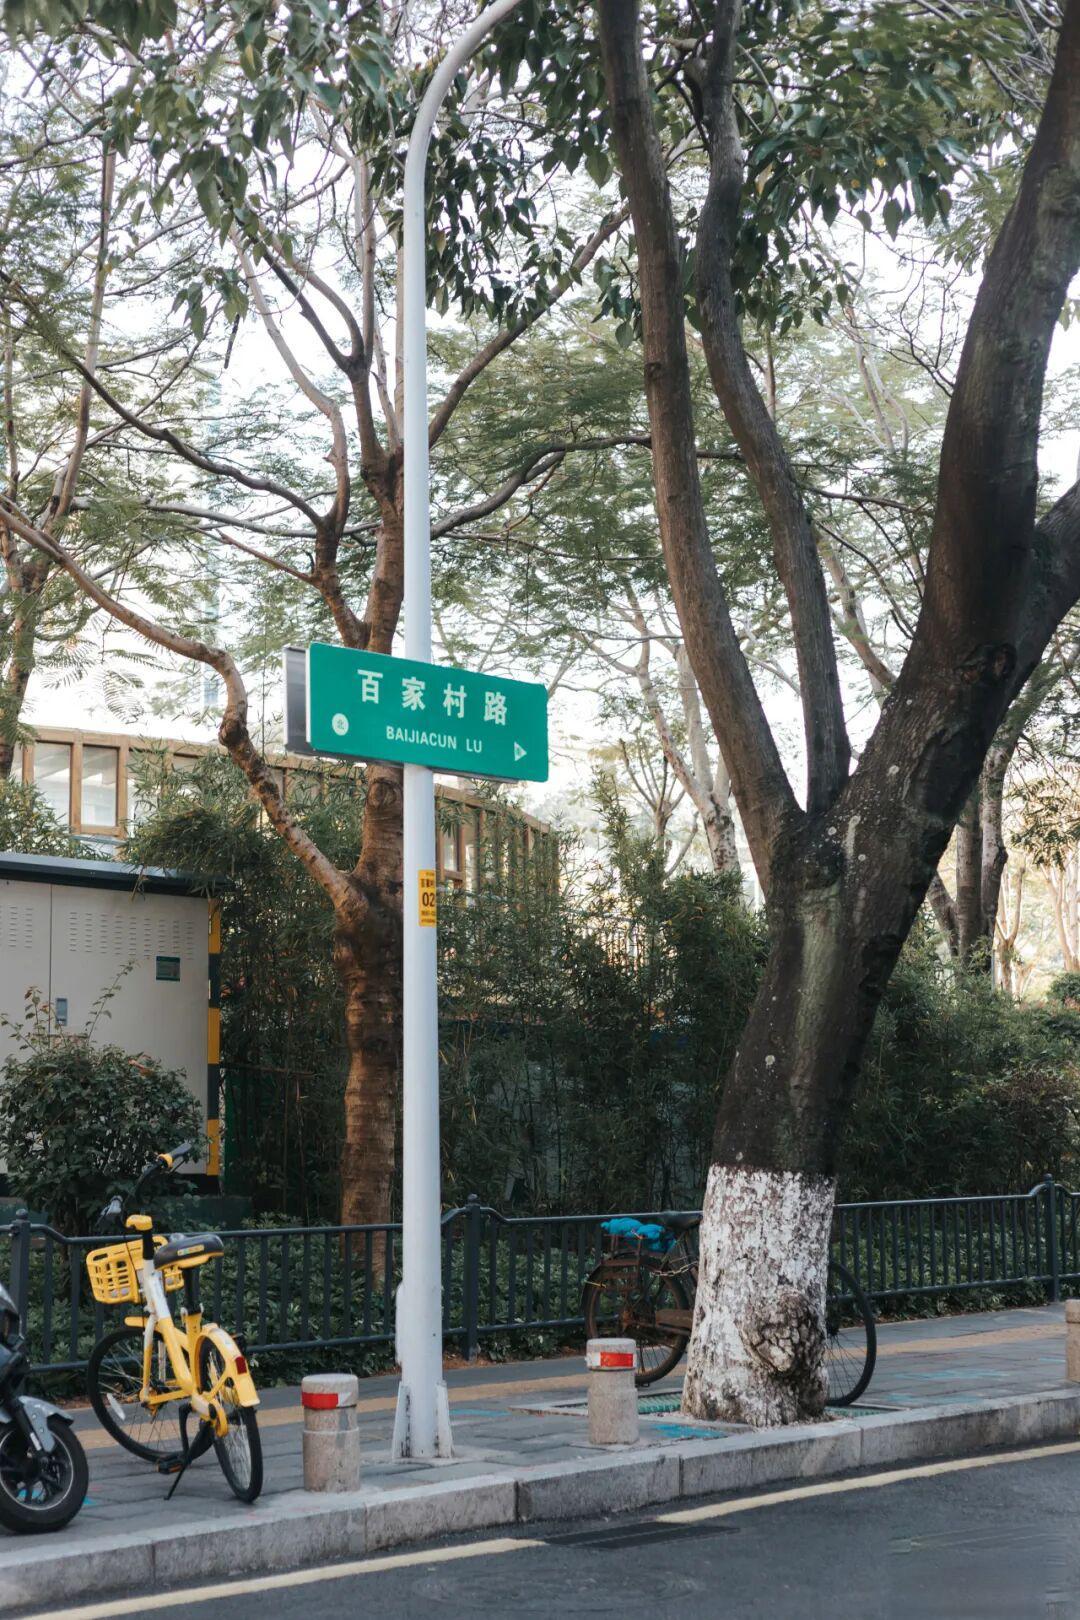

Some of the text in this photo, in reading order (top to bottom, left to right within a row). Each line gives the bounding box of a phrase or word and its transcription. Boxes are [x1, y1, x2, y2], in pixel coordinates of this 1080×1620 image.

[357, 668, 508, 726] 百家村路
[386, 725, 483, 753] BAIJIACUN LU
